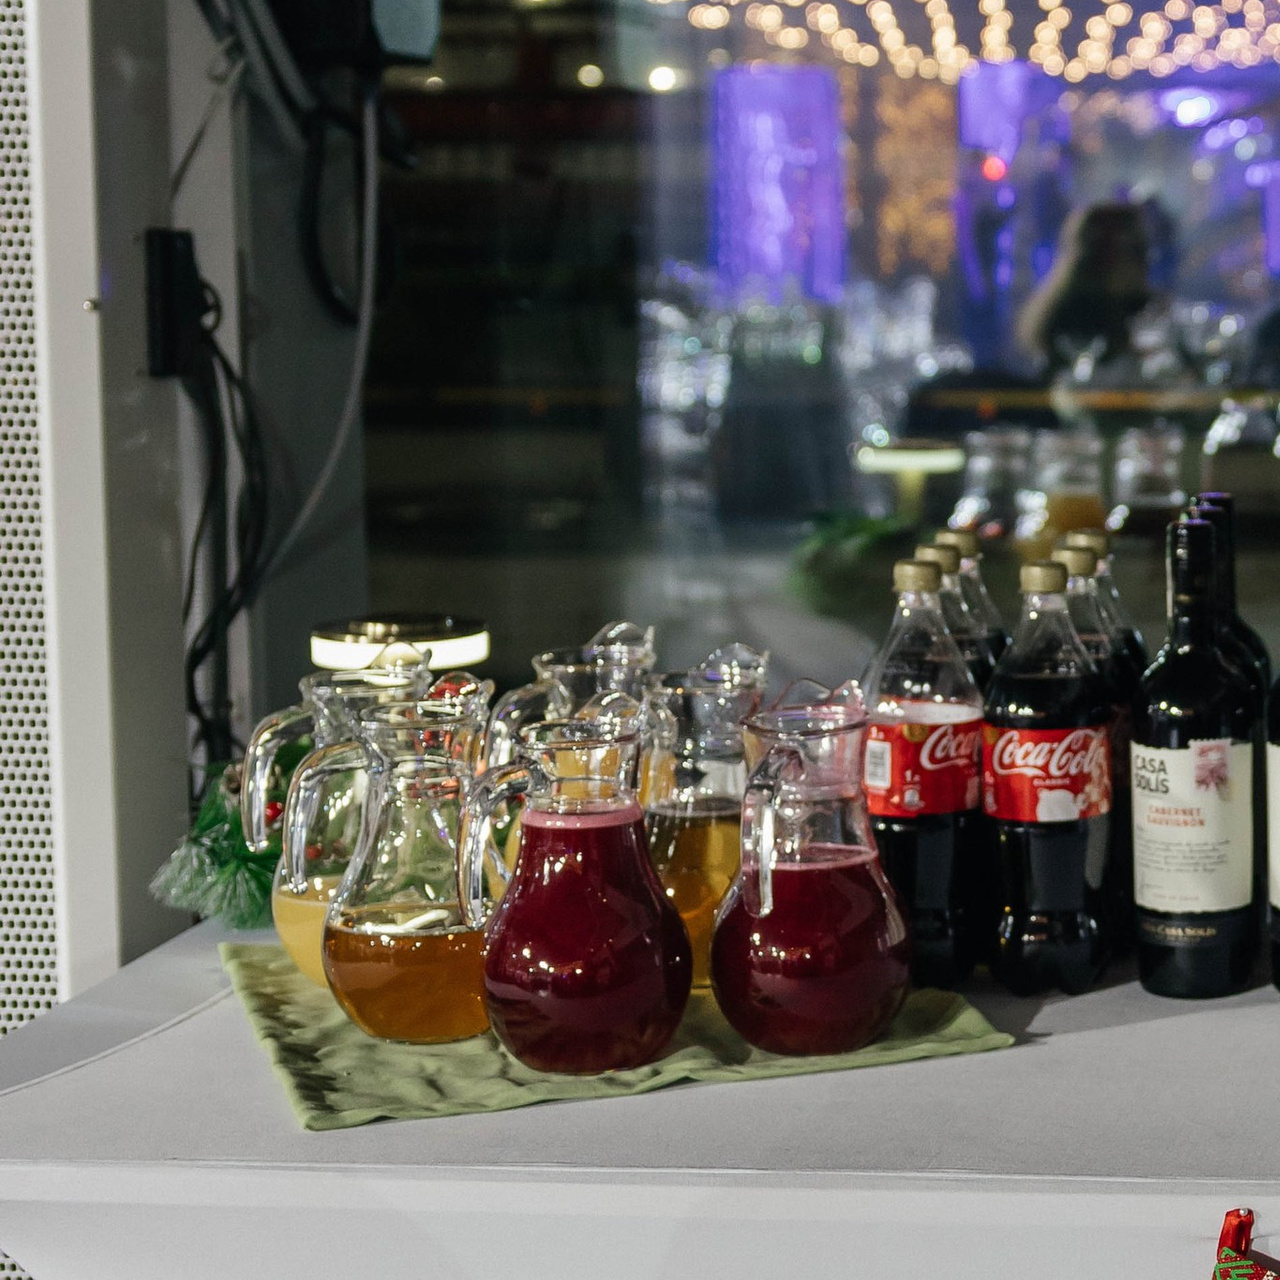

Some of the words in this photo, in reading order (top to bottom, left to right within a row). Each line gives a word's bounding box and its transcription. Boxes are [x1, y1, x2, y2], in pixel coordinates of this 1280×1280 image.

[1135, 754, 1168, 775] CASA
[1149, 805, 1201, 816] CABERNET
[1147, 815, 1206, 827] SAUVIGNON
